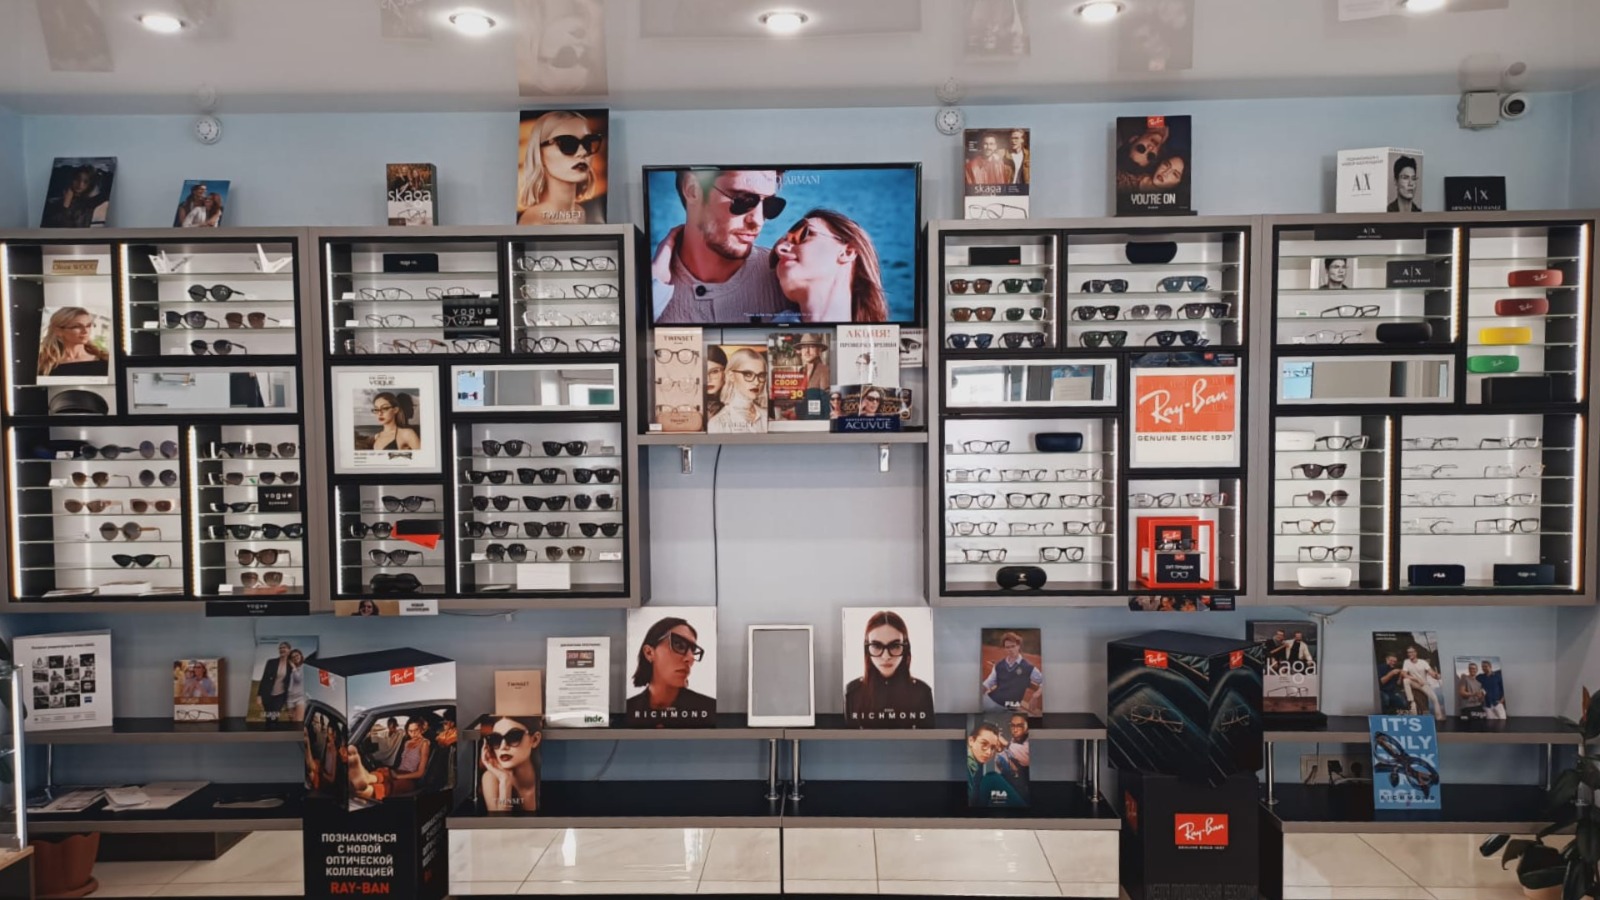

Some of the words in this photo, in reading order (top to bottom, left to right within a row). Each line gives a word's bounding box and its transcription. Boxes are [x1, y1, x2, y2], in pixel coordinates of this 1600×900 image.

[784, 175, 820, 185] ARMANI
[974, 183, 1002, 197] skaga
[388, 188, 432, 208] skaga
[1131, 193, 1161, 205] YOU'RE
[1163, 193, 1176, 204] ON
[452, 307, 492, 318] vogue
[790, 389, 804, 400] 30
[1139, 378, 1229, 425] Ray-Ban
[844, 421, 892, 430] ACUVUE
[1263, 657, 1318, 685] kaga
[635, 710, 708, 718] RICHMOND
[1381, 718, 1422, 732] IT'S
[1376, 736, 1432, 750] NLY
[1178, 817, 1224, 841] Ray-Ban
[321, 833, 397, 842] ПОЗНАКОМЬСЯ
[338, 845, 345, 853] С
[346, 843, 381, 853] НОВОЙ
[326, 854, 393, 865] ОПТИЧЕСКОЙ
[325, 866, 394, 877] КОЛЛЕКЦИЕЙ
[330, 882, 390, 894] RAY-BAN
